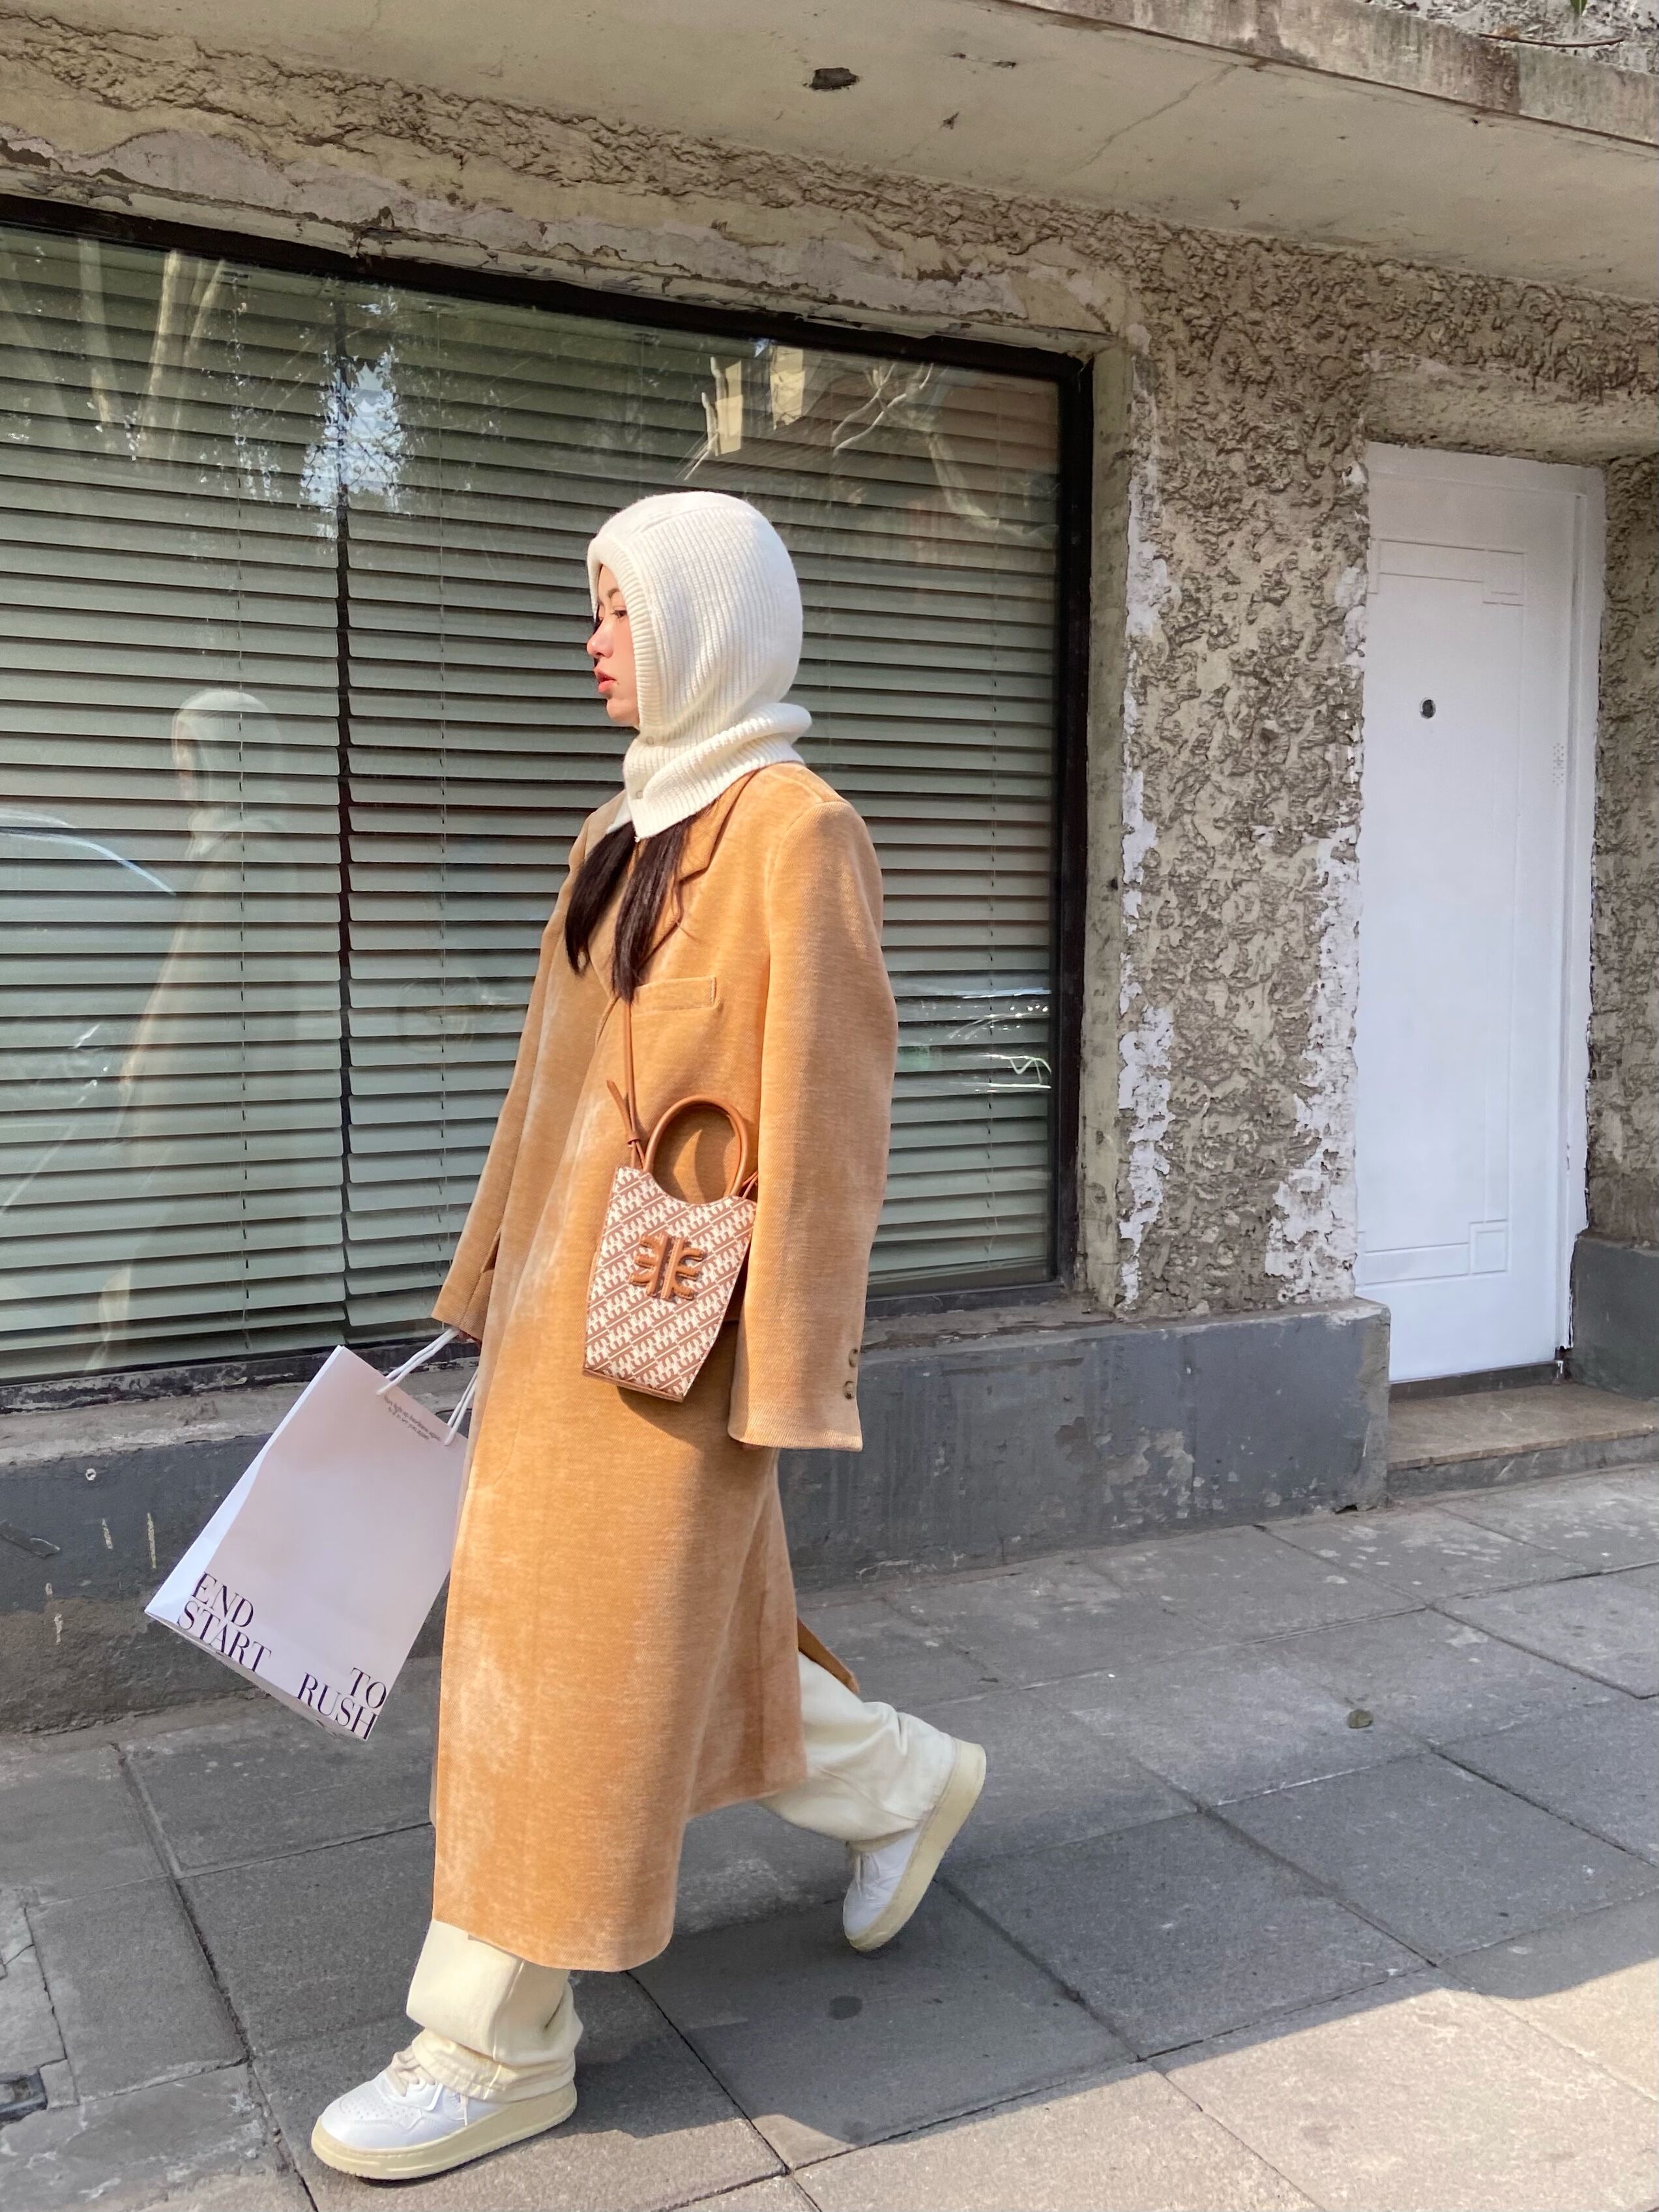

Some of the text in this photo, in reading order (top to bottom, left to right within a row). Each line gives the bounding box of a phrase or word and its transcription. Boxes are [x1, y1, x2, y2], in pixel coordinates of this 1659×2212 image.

[177, 1600, 379, 1740] START RUSH
[191, 1571, 387, 1709] END TO
